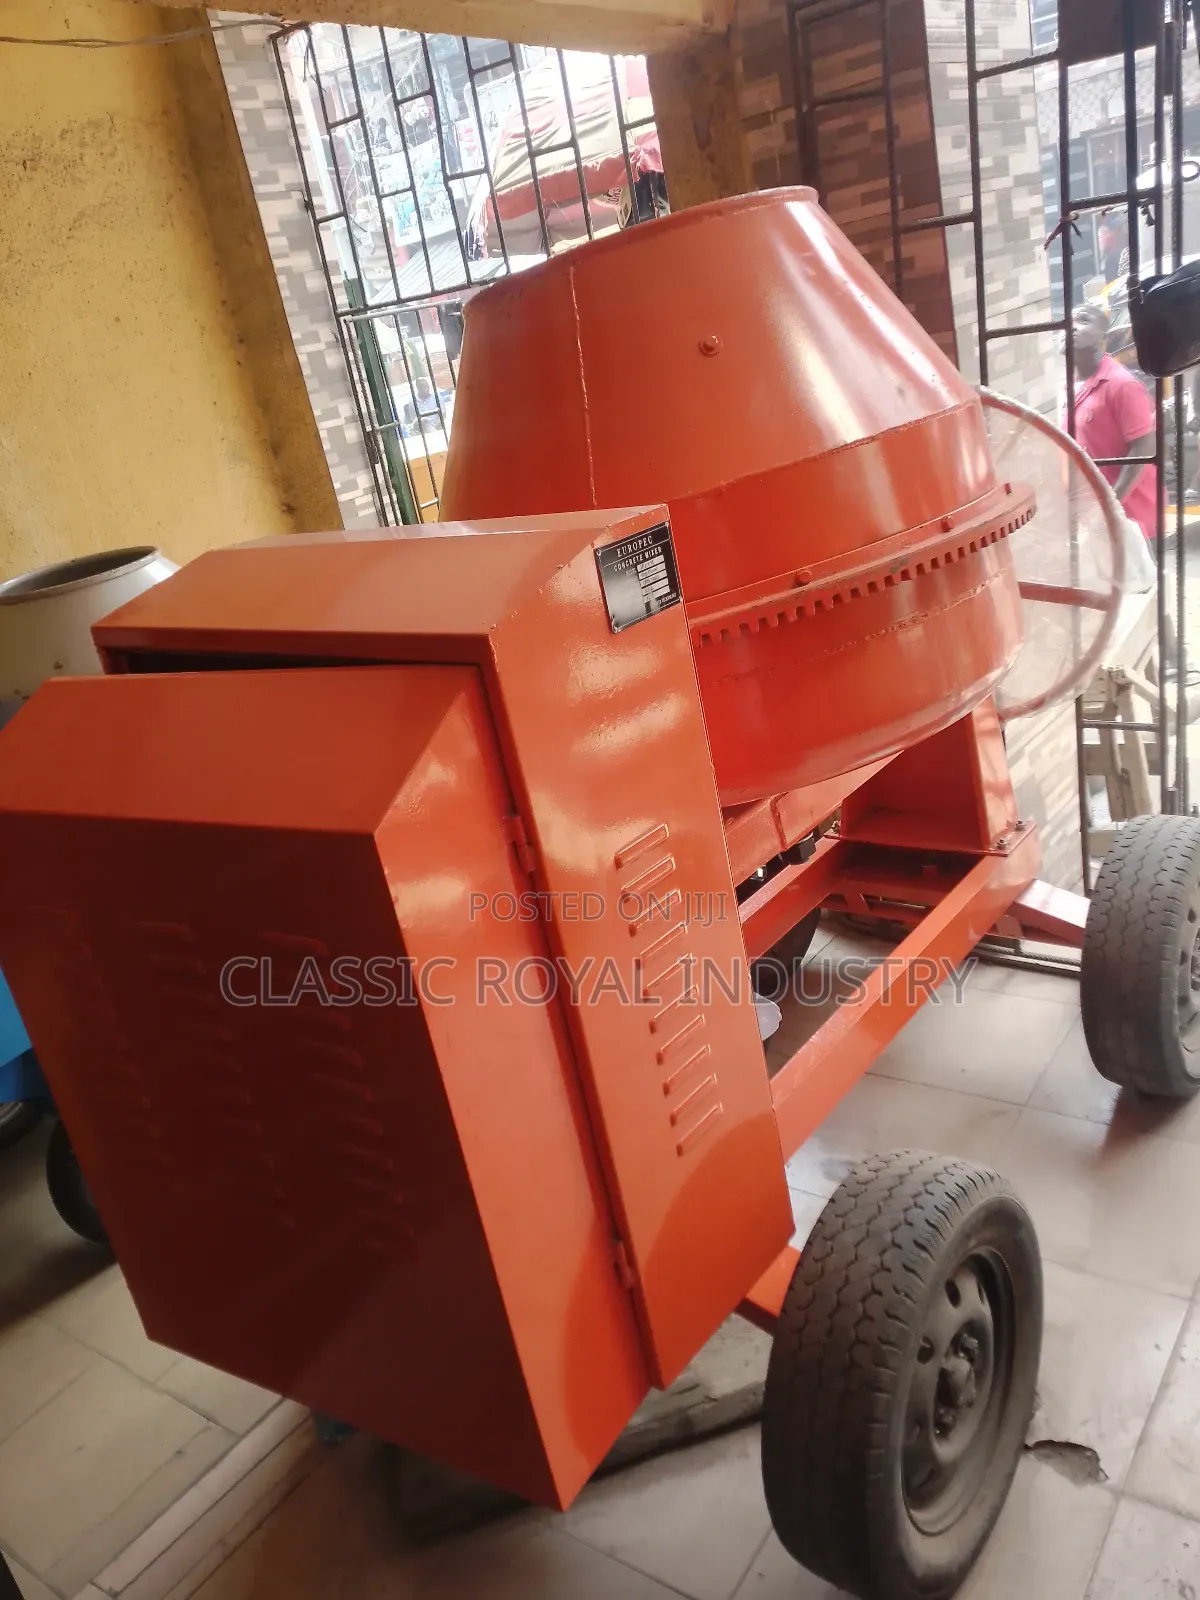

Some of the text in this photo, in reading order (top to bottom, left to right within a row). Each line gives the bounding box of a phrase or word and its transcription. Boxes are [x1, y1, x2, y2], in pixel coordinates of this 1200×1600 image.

[617, 536, 653, 557] EUROPEC
[613, 553, 643, 572] CONCRETE
[644, 546, 662, 559] MIXER
